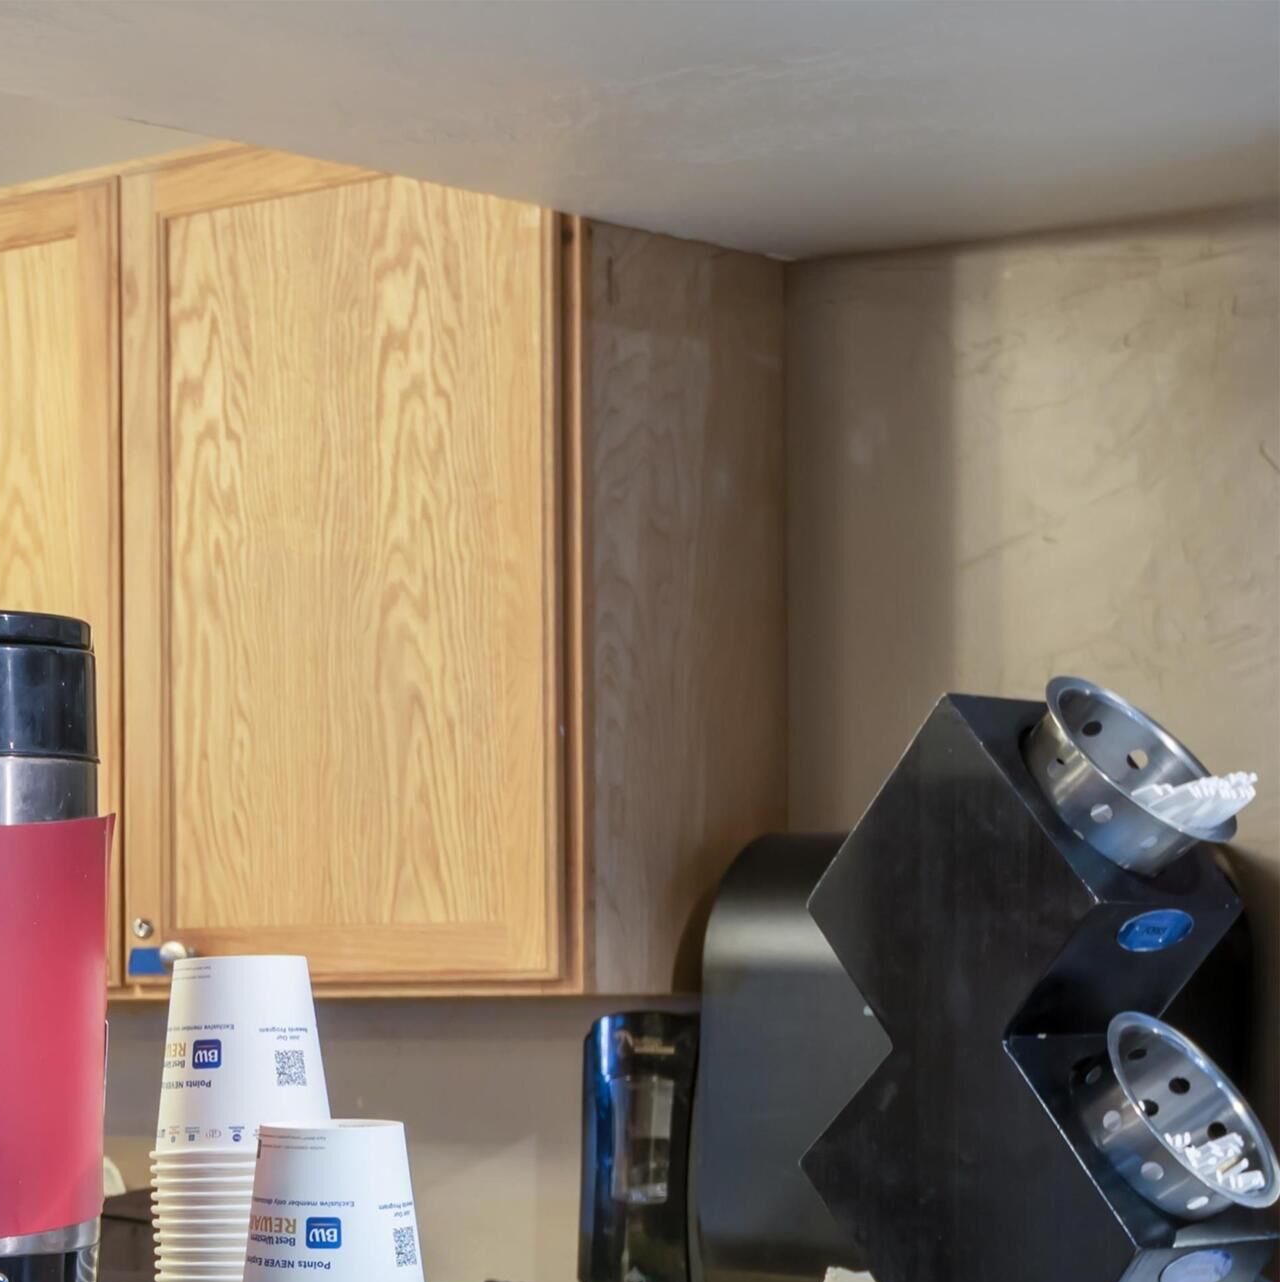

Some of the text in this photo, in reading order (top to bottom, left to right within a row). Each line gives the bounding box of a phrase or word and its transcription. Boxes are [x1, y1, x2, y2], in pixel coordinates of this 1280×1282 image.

[194, 1049, 218, 1063] BW
[308, 1228, 338, 1243] BW
[275, 1236, 296, 1247] Best
[264, 1258, 295, 1269] NEVER
[297, 1260, 331, 1270] Points
